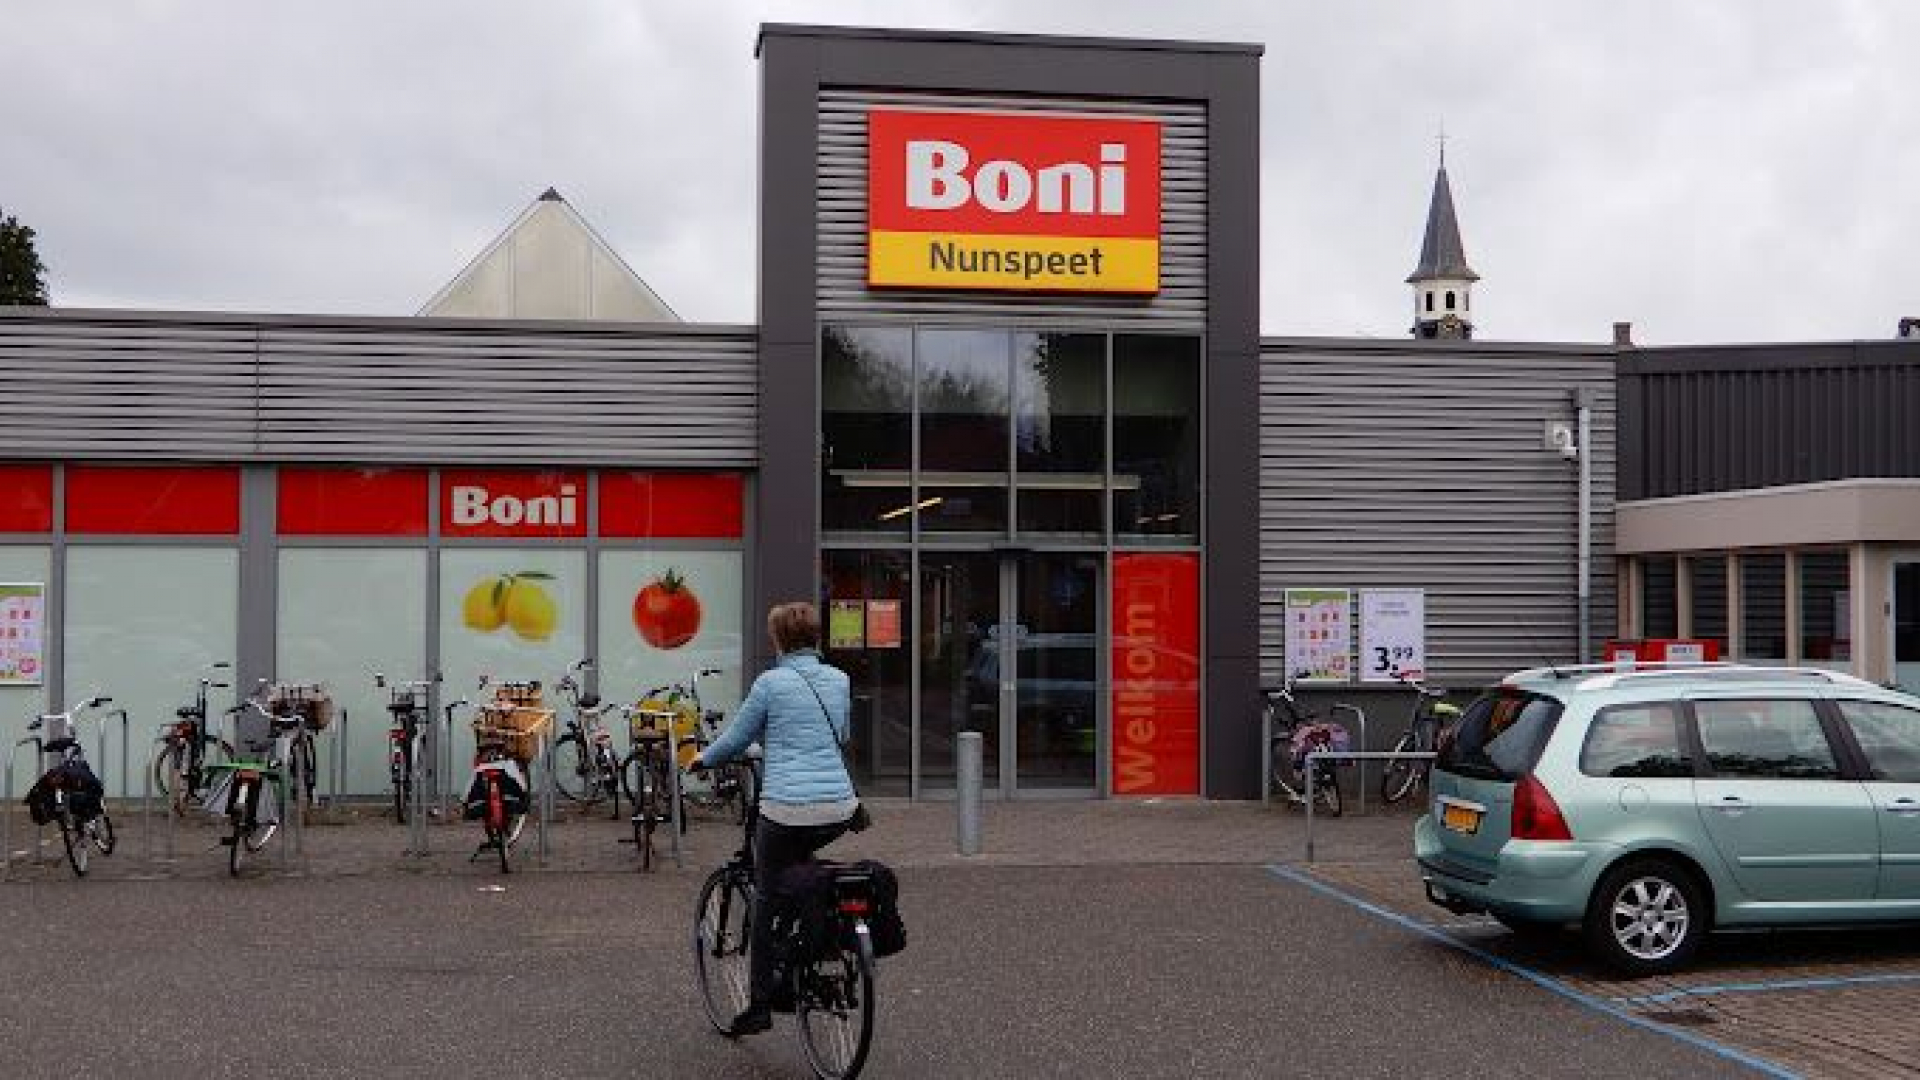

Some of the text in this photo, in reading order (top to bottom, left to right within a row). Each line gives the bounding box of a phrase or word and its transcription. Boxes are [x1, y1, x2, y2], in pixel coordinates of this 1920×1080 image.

[905, 140, 1127, 216] Boni
[929, 241, 1103, 280] Nunspeet
[451, 484, 576, 526] Boni
[1117, 604, 1156, 793] Welkom
